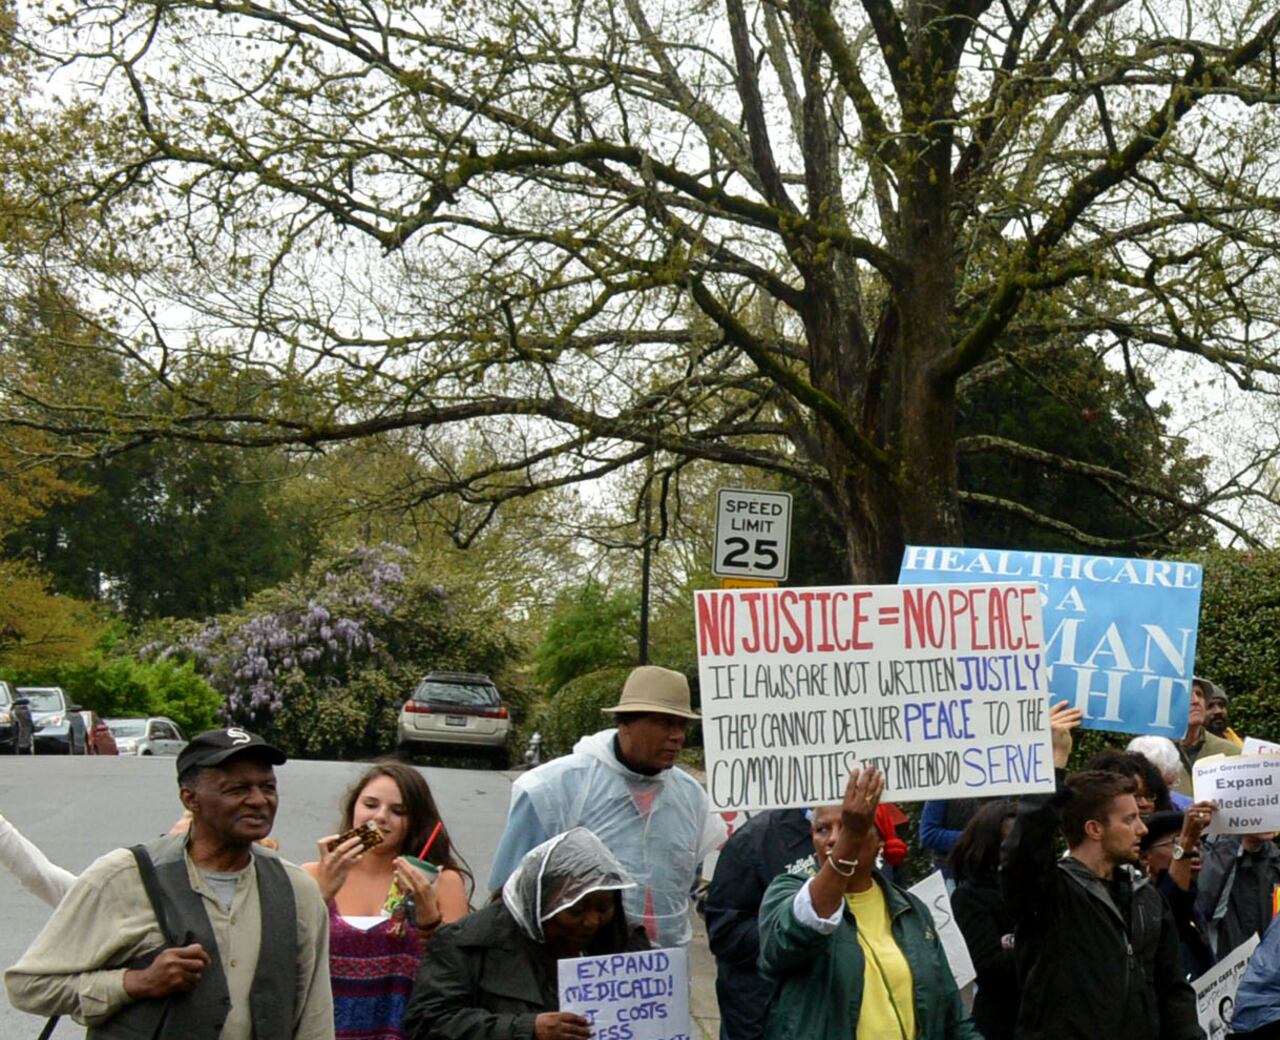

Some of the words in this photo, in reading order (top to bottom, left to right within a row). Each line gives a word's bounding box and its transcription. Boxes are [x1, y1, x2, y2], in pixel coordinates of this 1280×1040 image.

[725, 499, 783, 516] SPEED
[731, 518, 775, 533] LIMIT
[722, 537, 779, 570] 25
[904, 547, 1200, 589] HEALTHCARE
[1055, 586, 1087, 612] A
[697, 593, 735, 656] NO
[740, 590, 874, 654] JUSTICE
[903, 588, 945, 649] NO
[948, 587, 1040, 651] PEACE
[708, 664, 740, 700] IF
[743, 663, 795, 699] LAWS
[797, 664, 830, 696] ARE
[834, 661, 870, 697] NOT
[878, 657, 957, 696] WRITTEN
[957, 654, 1040, 691] JUSTLY
[711, 714, 757, 751] THEY
[761, 710, 827, 748] CANNOT
[833, 705, 902, 744] DELIVER
[904, 699, 975, 742] PEACE
[983, 700, 1010, 735] TO
[1017, 698, 1046, 732] THE
[1216, 775, 1273, 791] Expand
[1212, 794, 1279, 810] Medicaid
[1229, 817, 1262, 828] Now
[576, 952, 669, 979] EXPAND
[565, 975, 673, 1003] MEDICAID!
[617, 1001, 668, 1022] COSTS
